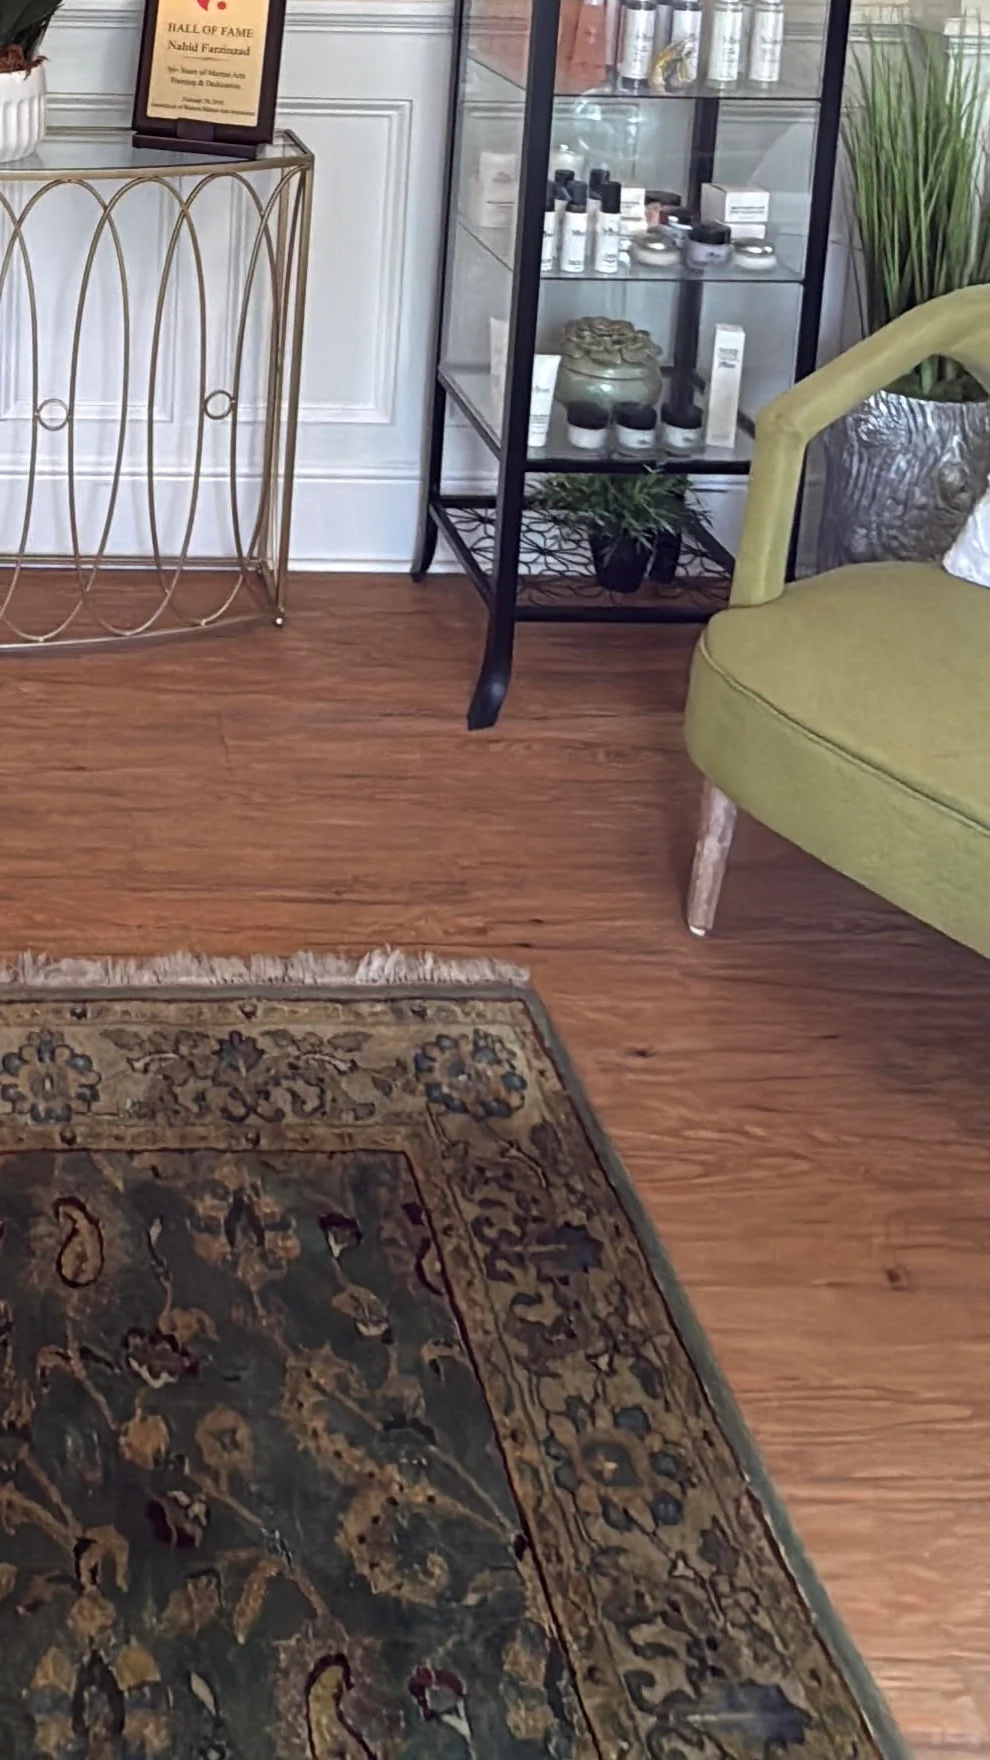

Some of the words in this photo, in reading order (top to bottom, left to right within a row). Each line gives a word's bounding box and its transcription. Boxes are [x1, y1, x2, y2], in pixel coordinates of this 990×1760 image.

[167, 22, 201, 34] HALL
[202, 25, 218, 36] OF
[221, 26, 254, 39] FAME
[167, 39, 198, 52] Nahid
